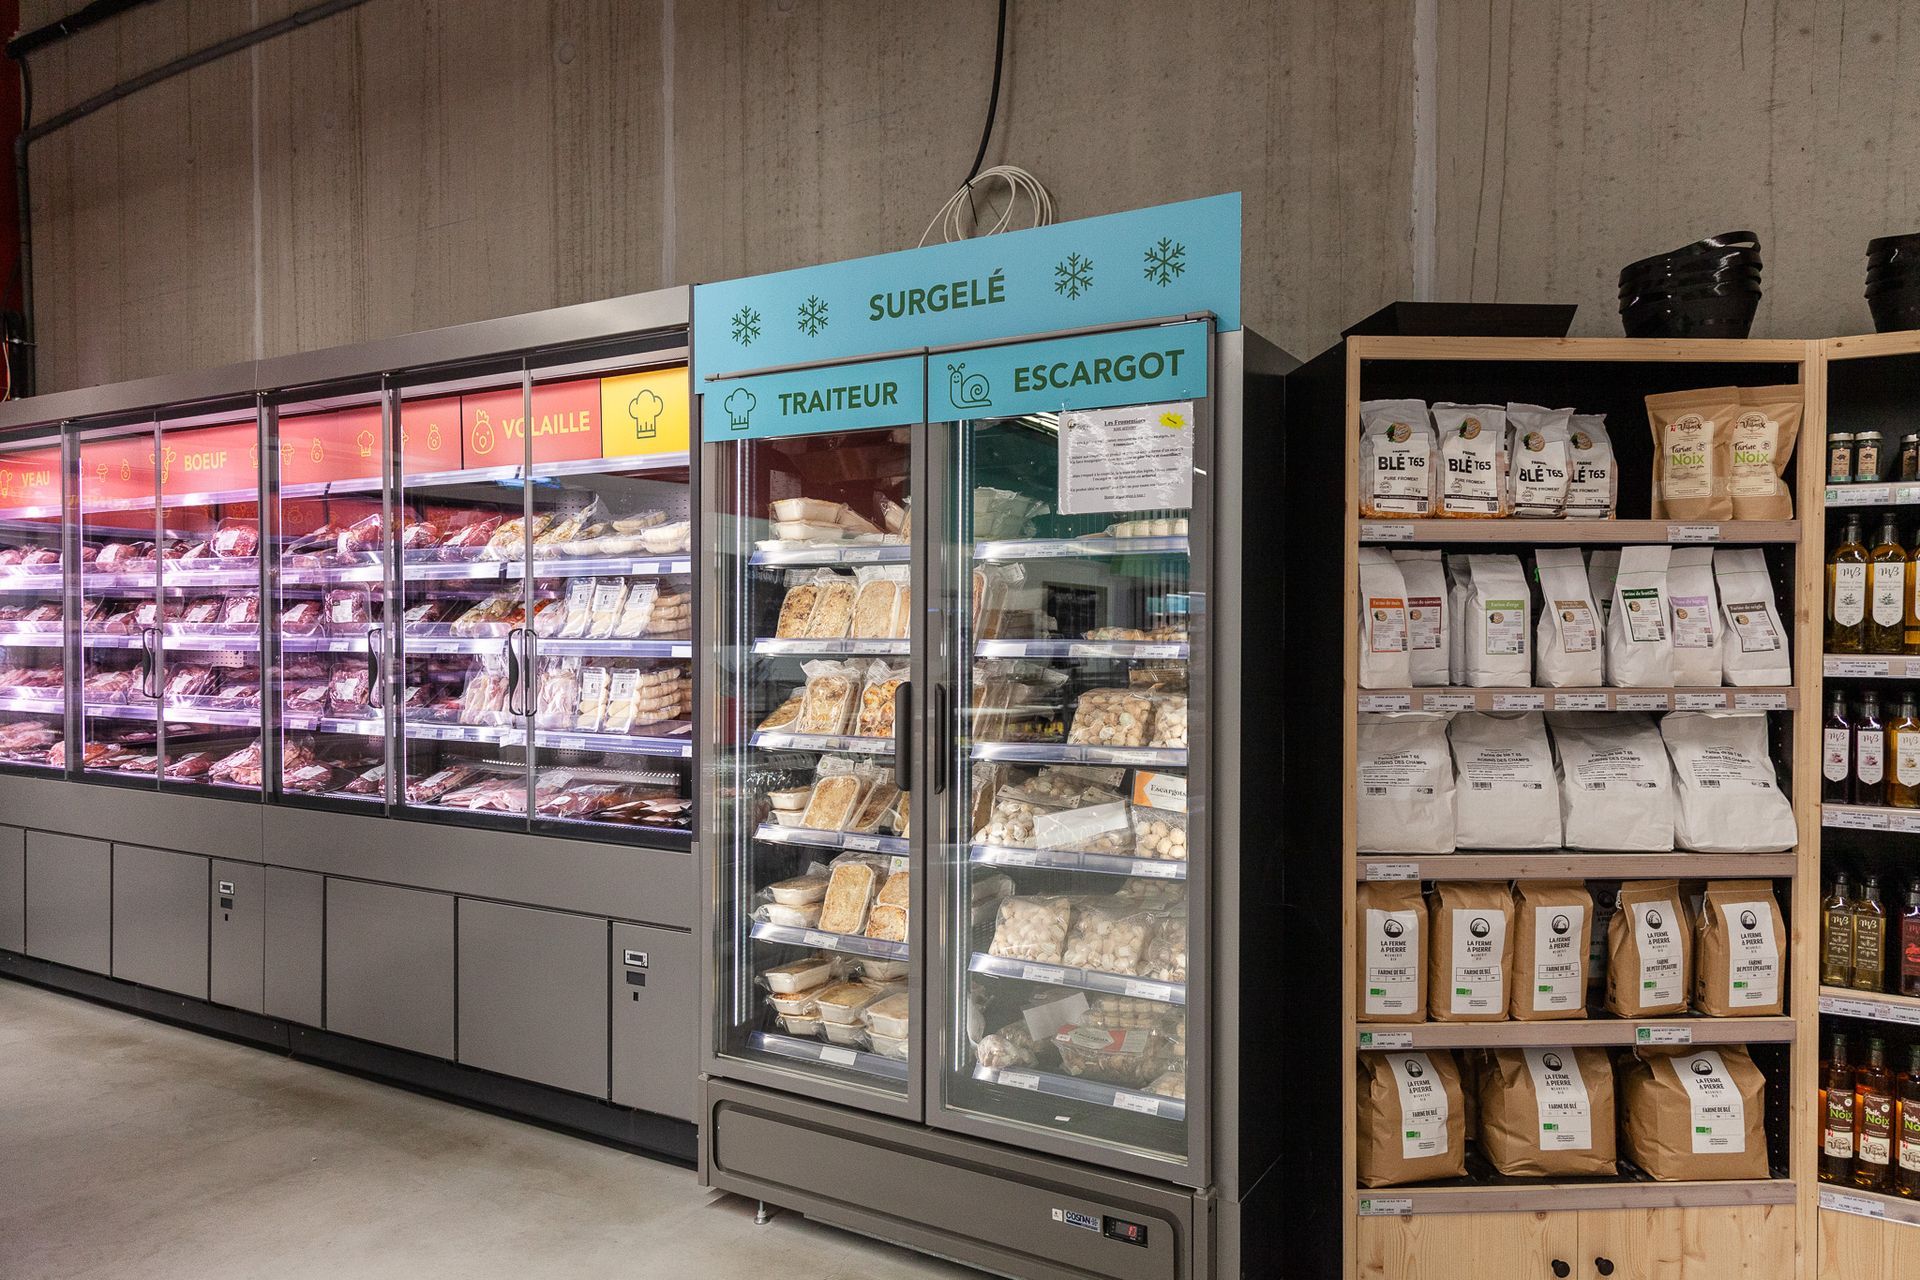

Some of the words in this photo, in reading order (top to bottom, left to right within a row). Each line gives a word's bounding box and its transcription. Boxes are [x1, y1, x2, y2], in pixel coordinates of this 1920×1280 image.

[869, 267, 1006, 321] SURGELÉ
[1014, 349, 1185, 392] ESCARGOT
[778, 381, 898, 416] TRAITEUR
[502, 410, 591, 440] VOLAILLE
[184, 451, 228, 472] BOEUF
[1378, 453, 1405, 470] BLÉ
[1408, 457, 1424, 467] T65
[1448, 456, 1472, 474] BLÉ
[1474, 460, 1491, 470] T65
[1671, 452, 1705, 465] Noix
[1734, 450, 1768, 464] Noix
[21, 470, 50, 487] VEAU
[1519, 465, 1544, 482] BLÉ
[1546, 469, 1564, 478] T65
[1571, 466, 1586, 483] LÉ
[1588, 469, 1606, 479] T65
[1414, 1079, 1431, 1087] FERME
[1412, 1110, 1426, 1118] FARINE
[1430, 1107, 1438, 1116] BLÉ
[1829, 1108, 1853, 1119] Noix
[1866, 1113, 1890, 1125] Noix
[1904, 1119, 1920, 1131] No
[1065, 1210, 1091, 1225] COSTAN
